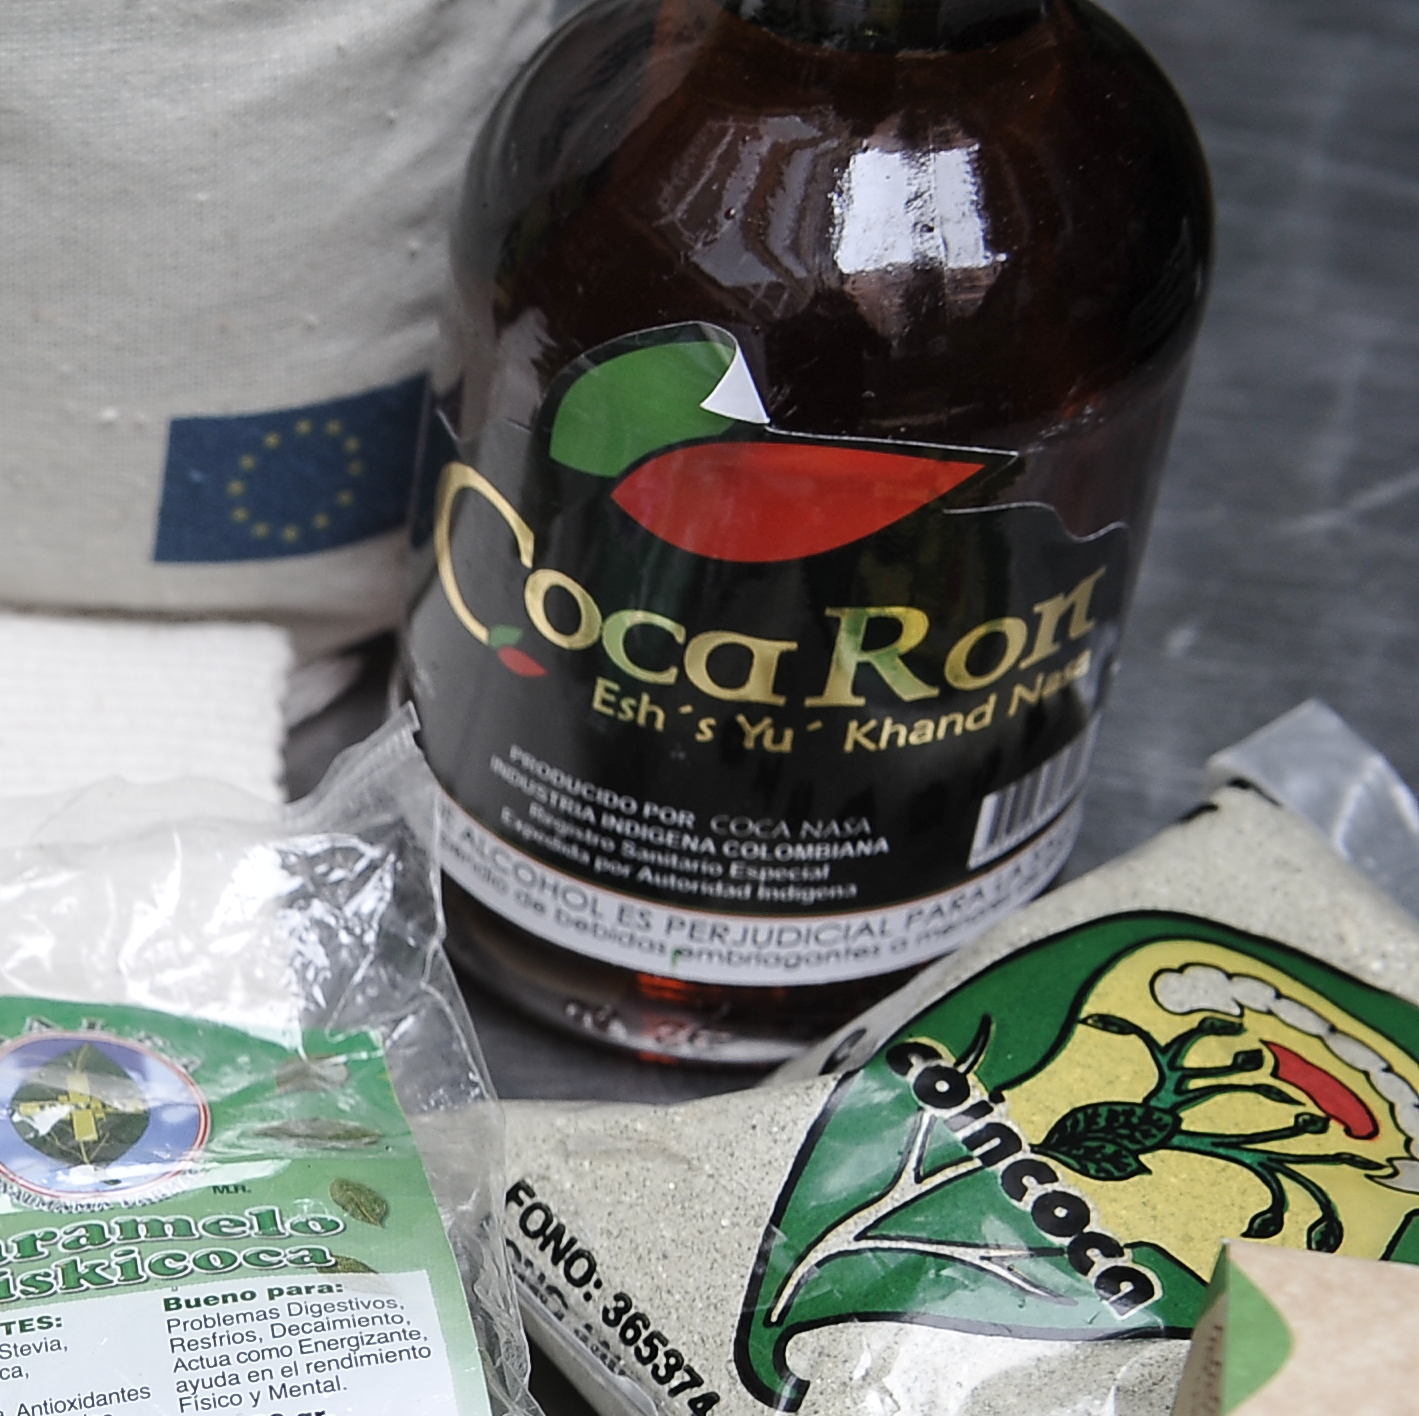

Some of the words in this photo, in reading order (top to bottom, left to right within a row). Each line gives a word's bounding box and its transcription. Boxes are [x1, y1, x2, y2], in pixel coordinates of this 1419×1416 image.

[434, 461, 798, 707] Coca
[804, 567, 1107, 709] Ron
[843, 694, 997, 753] Khand
[1007, 650, 1094, 718] Nasa
[490, 754, 597, 826] INDUSTRIA
[600, 811, 717, 856] INDIGENA
[722, 836, 890, 862] COLOMBIANA
[509, 744, 639, 817] PRODUCIDO
[642, 800, 697, 830] POR
[710, 813, 791, 840] COCA
[800, 816, 872, 840] NASA
[527, 802, 616, 854] Registro
[620, 842, 723, 878] Sanitario
[728, 863, 830, 884] Especial
[462, 829, 603, 920] ALCOHOL
[618, 903, 654, 930] ES
[666, 915, 894, 951] PERJUDICIAL
[593, 854, 631, 879] por
[636, 865, 752, 899] Autoridad
[553, 904, 668, 955] bebidas
[505, 1180, 603, 1303] FONO:
[163, 1289, 257, 1312] Bueno
[267, 1281, 344, 1301] para:
[166, 1305, 280, 1335] Problemas
[287, 1298, 405, 1320] Digestivos,
[173, 1353, 231, 1374] Actua
[236, 1347, 293, 1365] como
[299, 1329, 428, 1356] Energizante,
[270, 1312, 412, 1339] Decaimiento,
[176, 1370, 241, 1397] ayuda
[247, 1366, 274, 1382] en
[280, 1361, 299, 1378] el
[306, 1345, 432, 1374] rendimiento
[248, 1389, 261, 1408] y
[268, 1376, 348, 1402] Mental.
